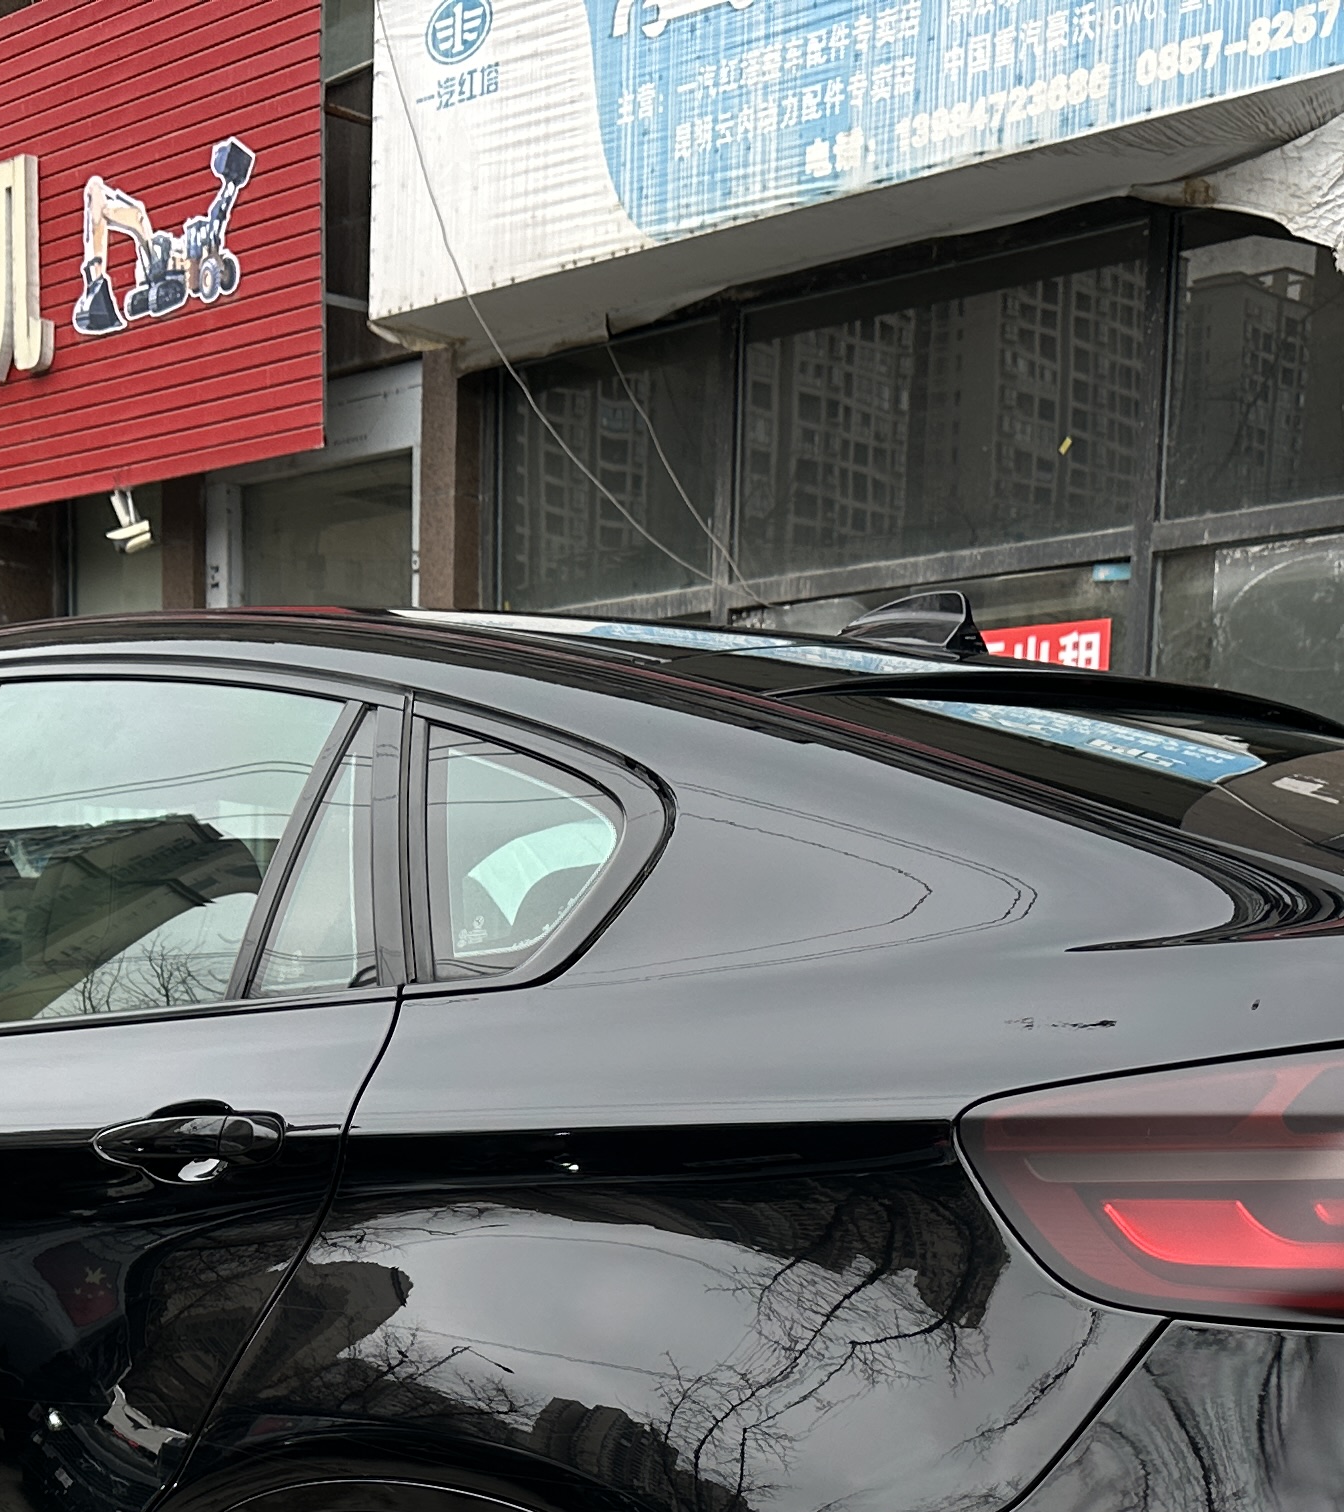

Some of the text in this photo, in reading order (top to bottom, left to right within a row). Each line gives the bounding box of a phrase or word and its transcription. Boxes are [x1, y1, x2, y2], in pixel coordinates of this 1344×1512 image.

[415, 61, 500, 111] 一汽红塔
[987, 630, 1100, 670] 出租
